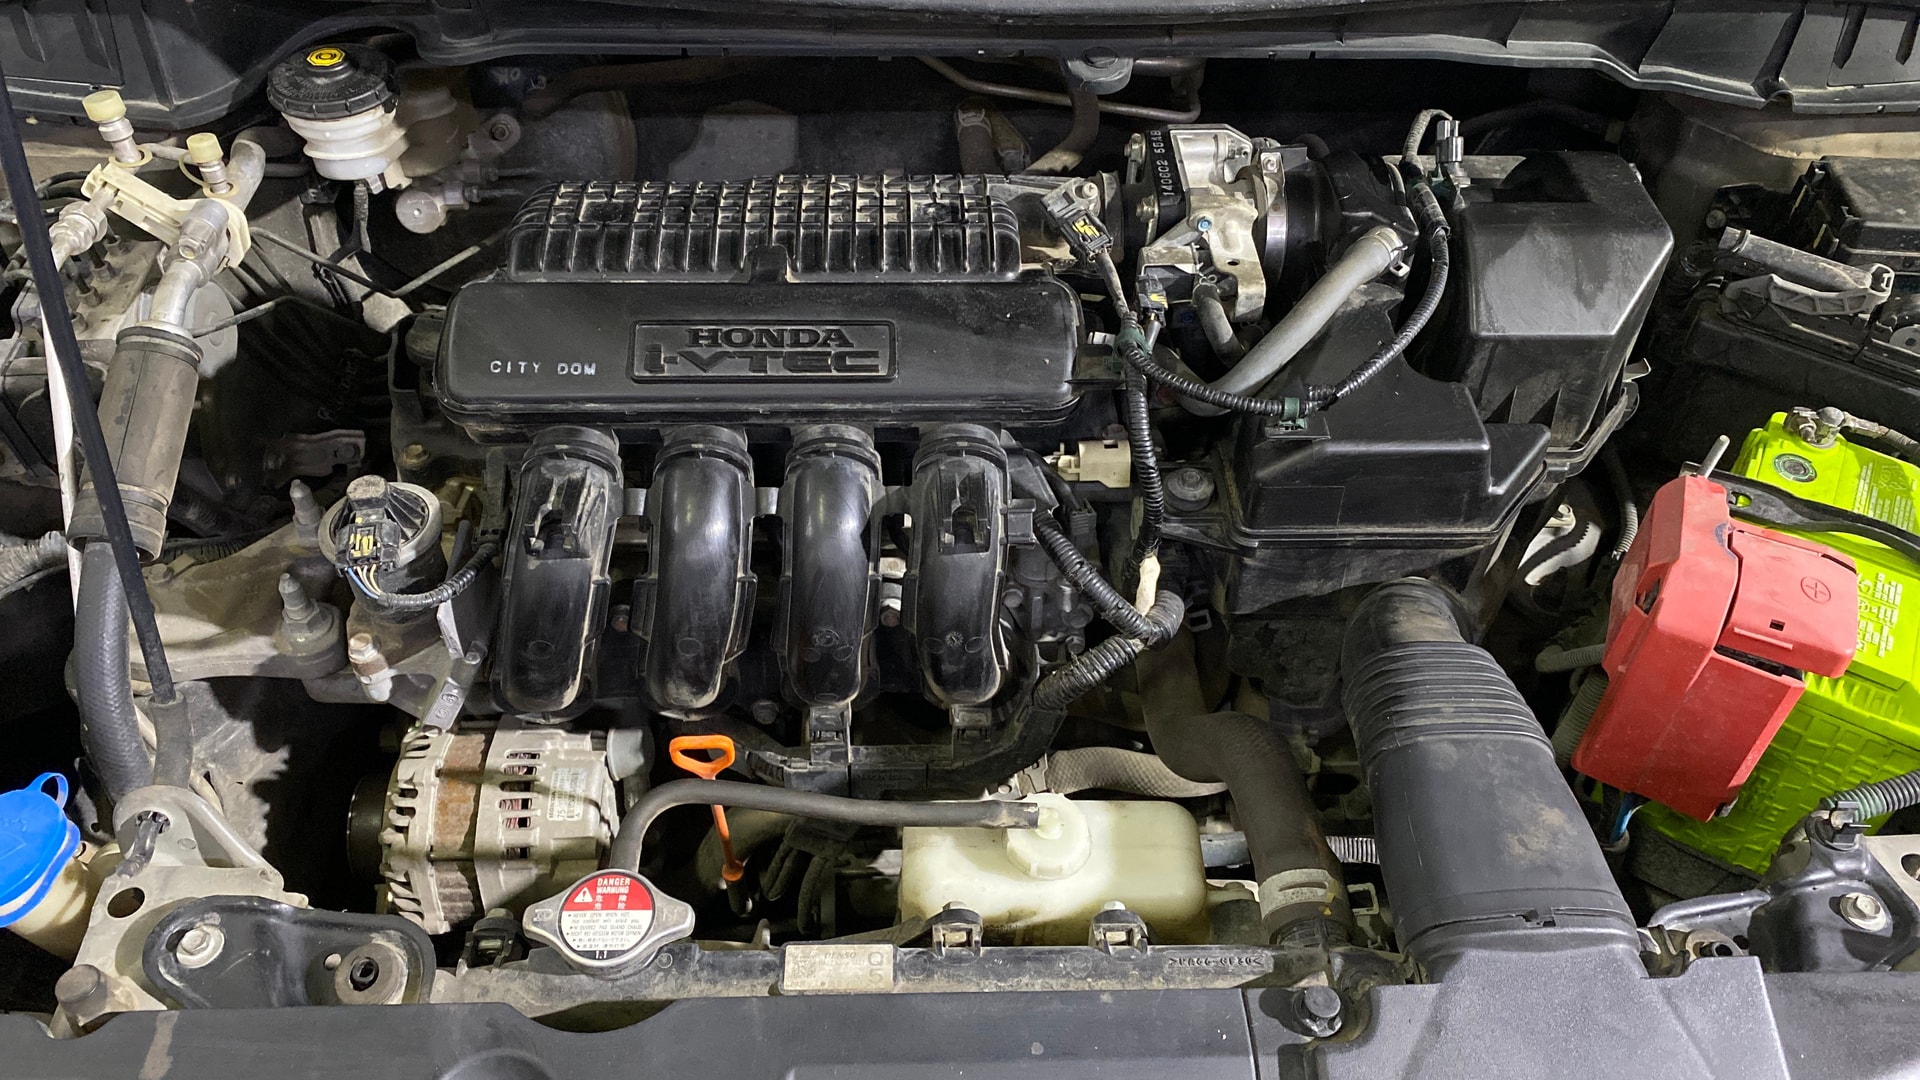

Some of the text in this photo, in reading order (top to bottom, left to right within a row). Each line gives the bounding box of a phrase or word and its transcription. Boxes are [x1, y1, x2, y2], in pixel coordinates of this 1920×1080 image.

[685, 328, 854, 348] HONDA
[490, 360, 596, 375] CITY DOM
[597, 877, 631, 886] DANGER
[824, 951, 857, 959] DENSO
